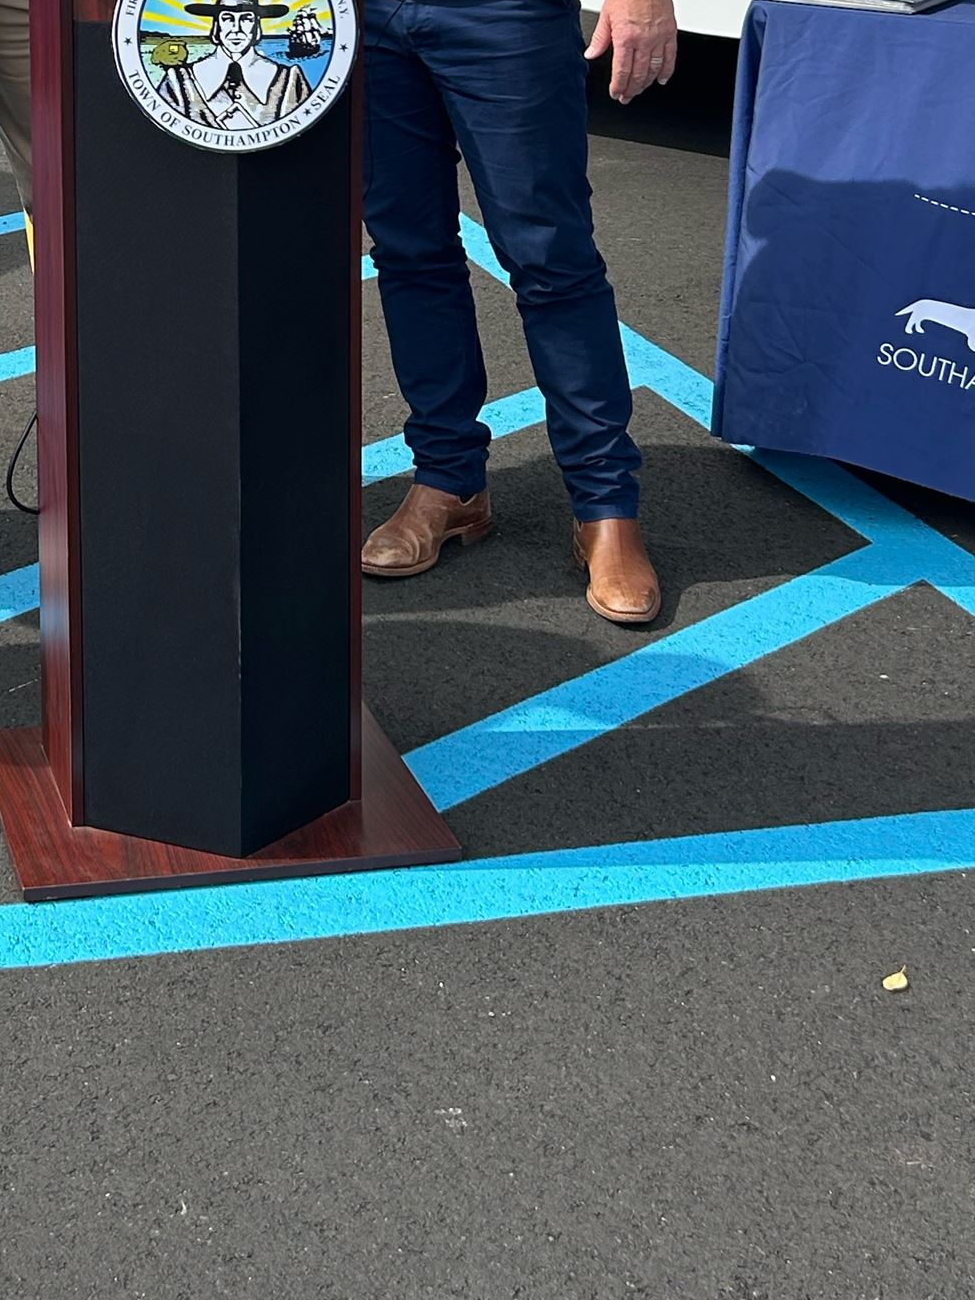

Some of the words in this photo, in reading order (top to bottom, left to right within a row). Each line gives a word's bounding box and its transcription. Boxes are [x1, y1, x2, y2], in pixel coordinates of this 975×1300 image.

[128, 70, 161, 112] TOWN
[160, 111, 181, 128] OF
[181, 115, 302, 147] SOUTHAMPTON
[310, 76, 341, 111] SEAL
